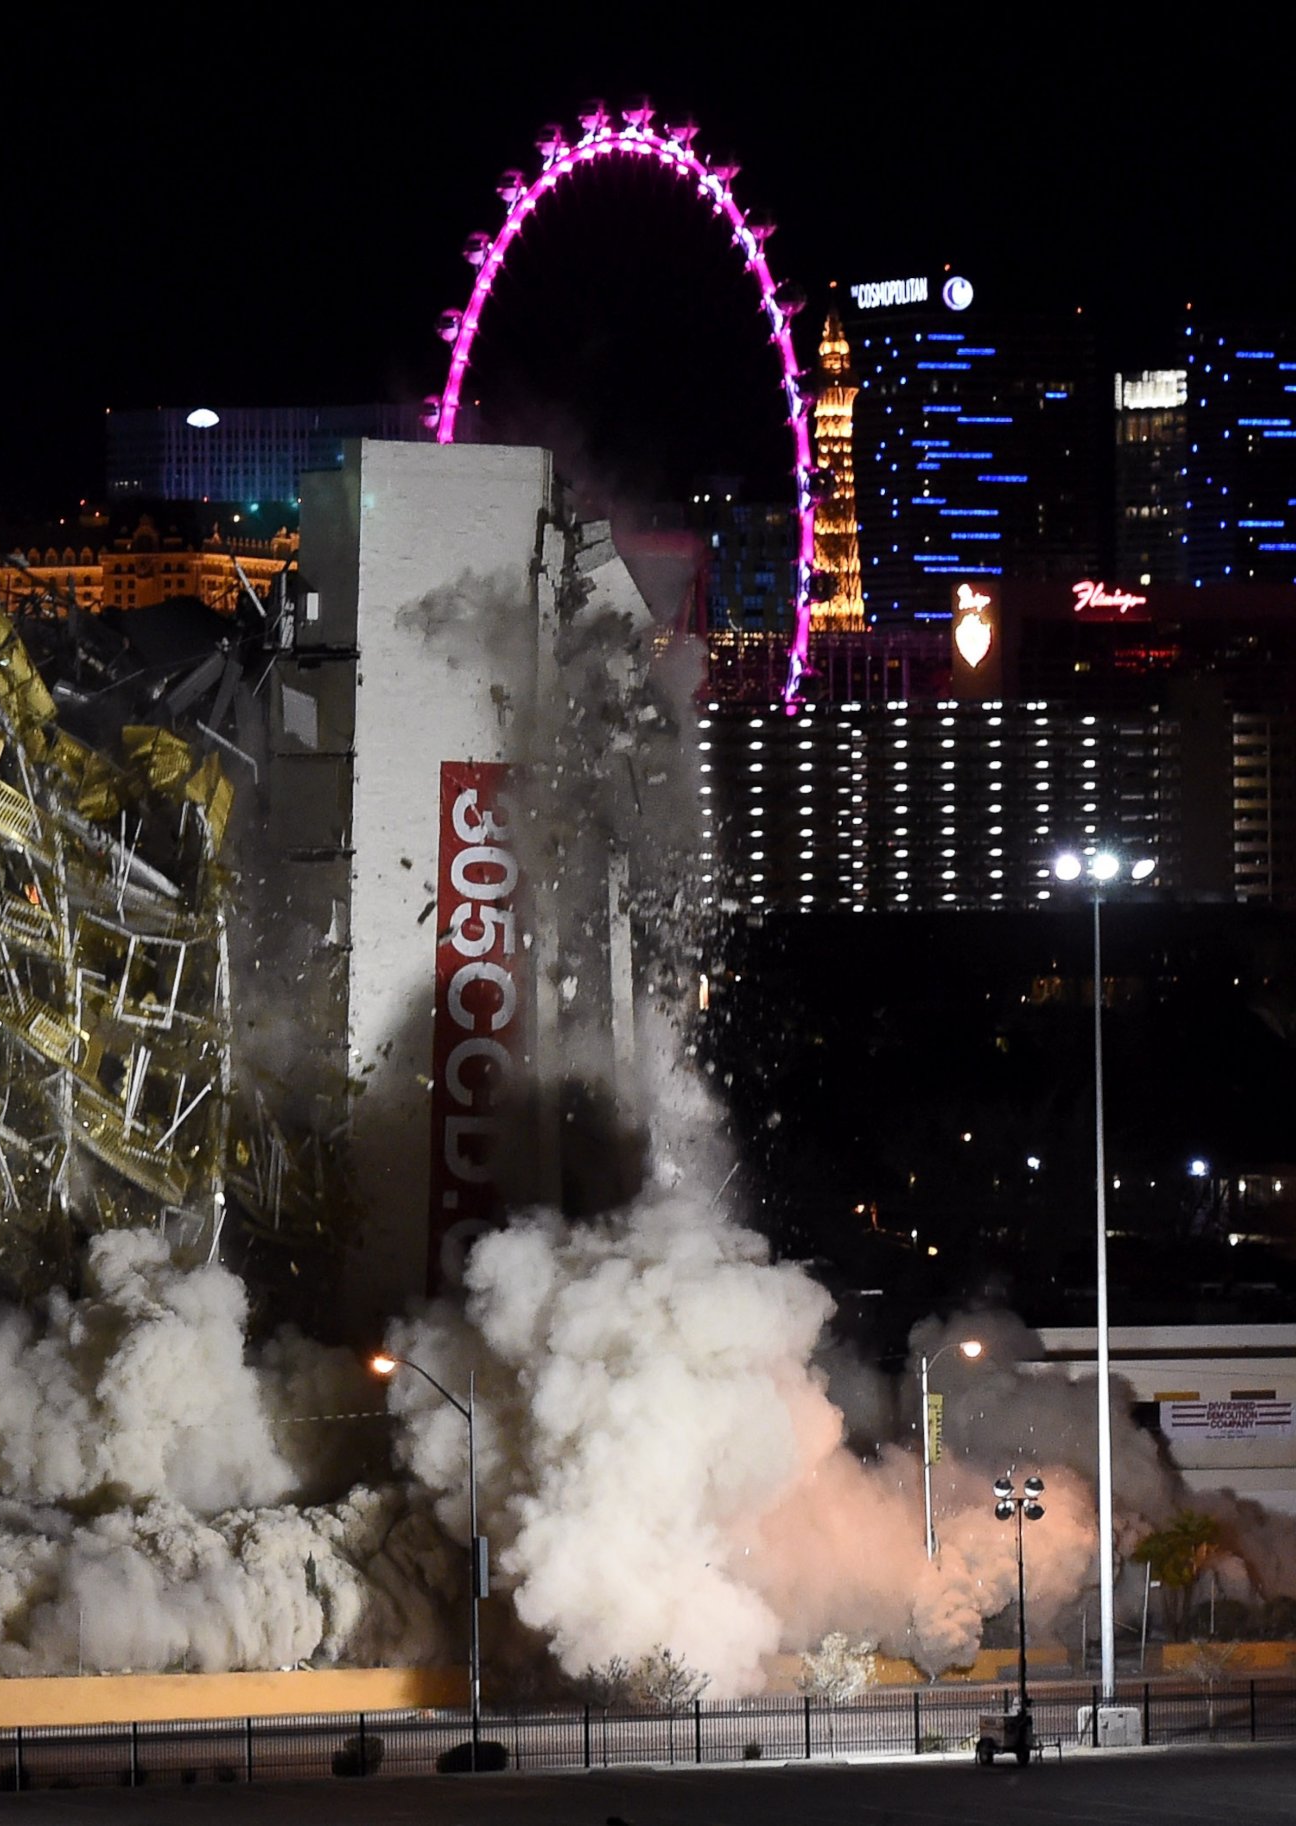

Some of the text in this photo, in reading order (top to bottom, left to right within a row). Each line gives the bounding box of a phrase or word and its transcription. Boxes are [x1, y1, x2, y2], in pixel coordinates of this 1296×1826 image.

[858, 278, 927, 308] COSMOPOLITAN
[1208, 1402, 1256, 1411] DIVERSIFIED
[1206, 1410, 1258, 1420] DEMOLITION
[1210, 1419, 1255, 1429] COMPANY
